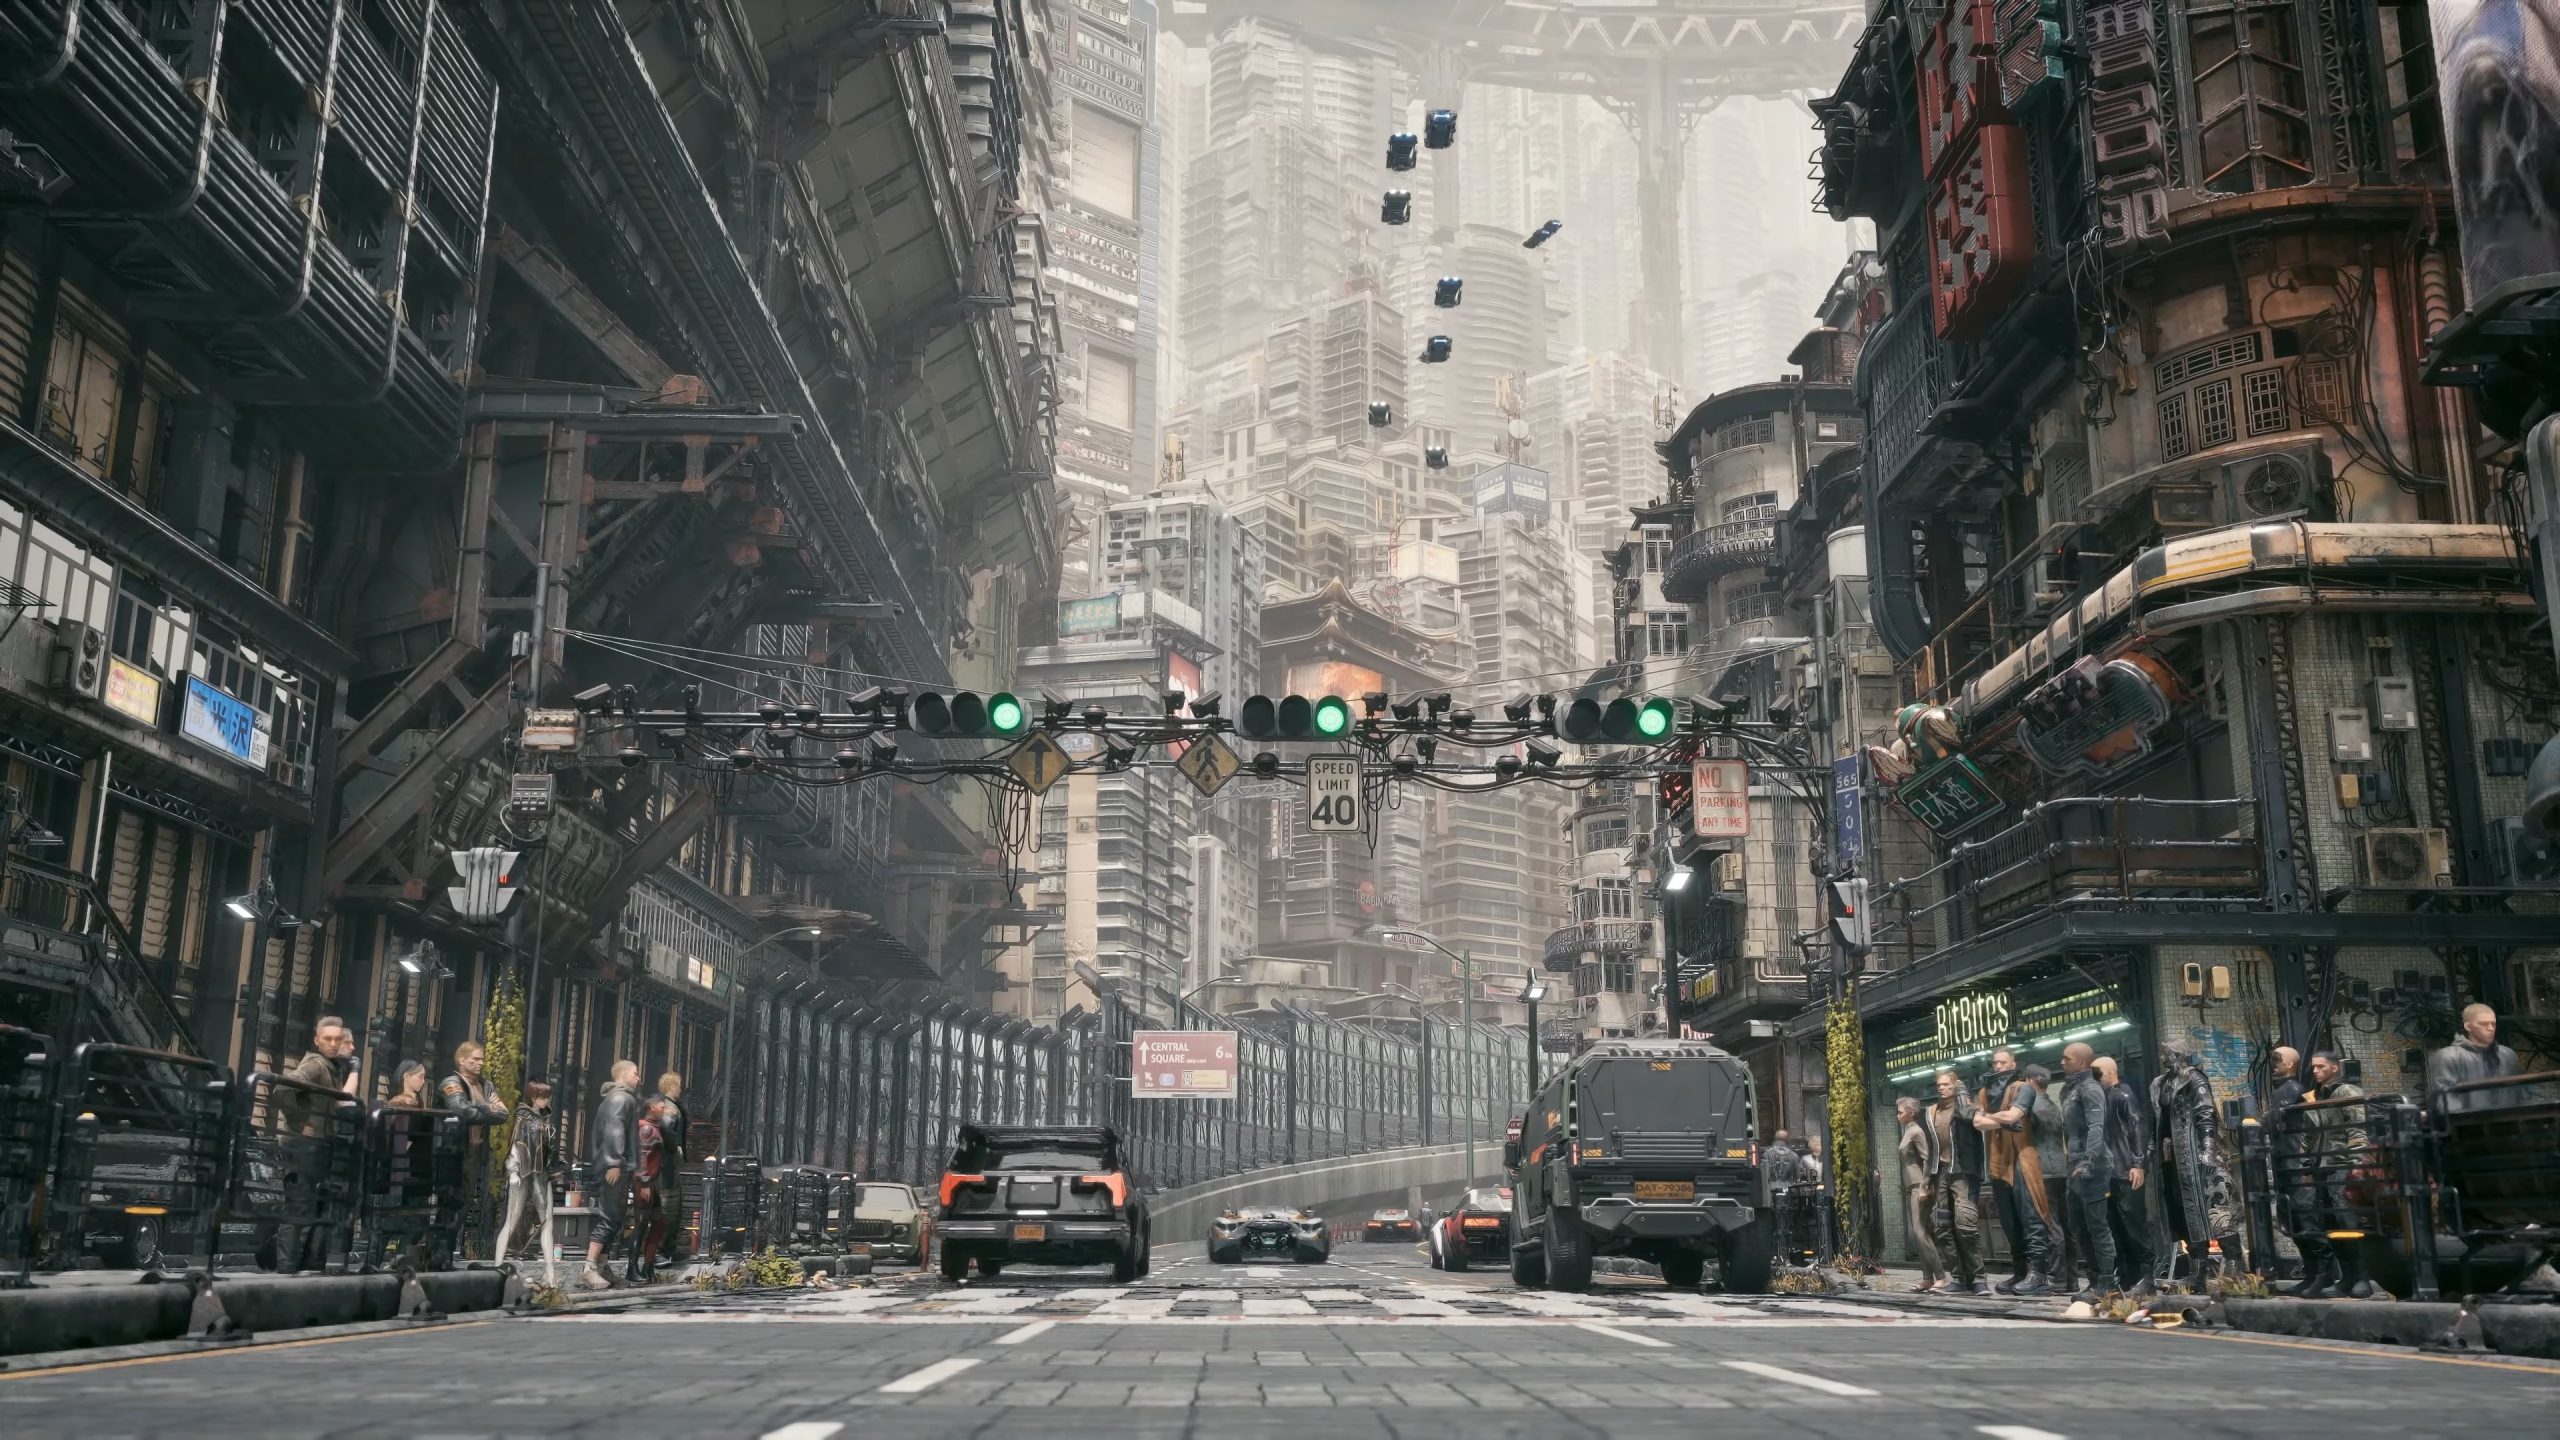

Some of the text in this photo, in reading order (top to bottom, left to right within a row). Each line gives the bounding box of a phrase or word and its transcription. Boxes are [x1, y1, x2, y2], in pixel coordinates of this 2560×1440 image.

[1314, 762, 1354, 775] SPEED
[1318, 779, 1351, 791] LIMIT
[1698, 766, 1722, 789] NO
[1836, 773, 1857, 789] 565
[1311, 794, 1356, 826] 40
[1700, 796, 1743, 808] PARKING
[1907, 777, 1980, 829] 日本酒
[1702, 817, 1743, 828] ANY TIME
[1936, 990, 2009, 1049] BitBites
[1151, 1042, 1189, 1052] CENTRAL
[1215, 1046, 1224, 1059] 6
[1151, 1054, 1185, 1064] SQUARE
